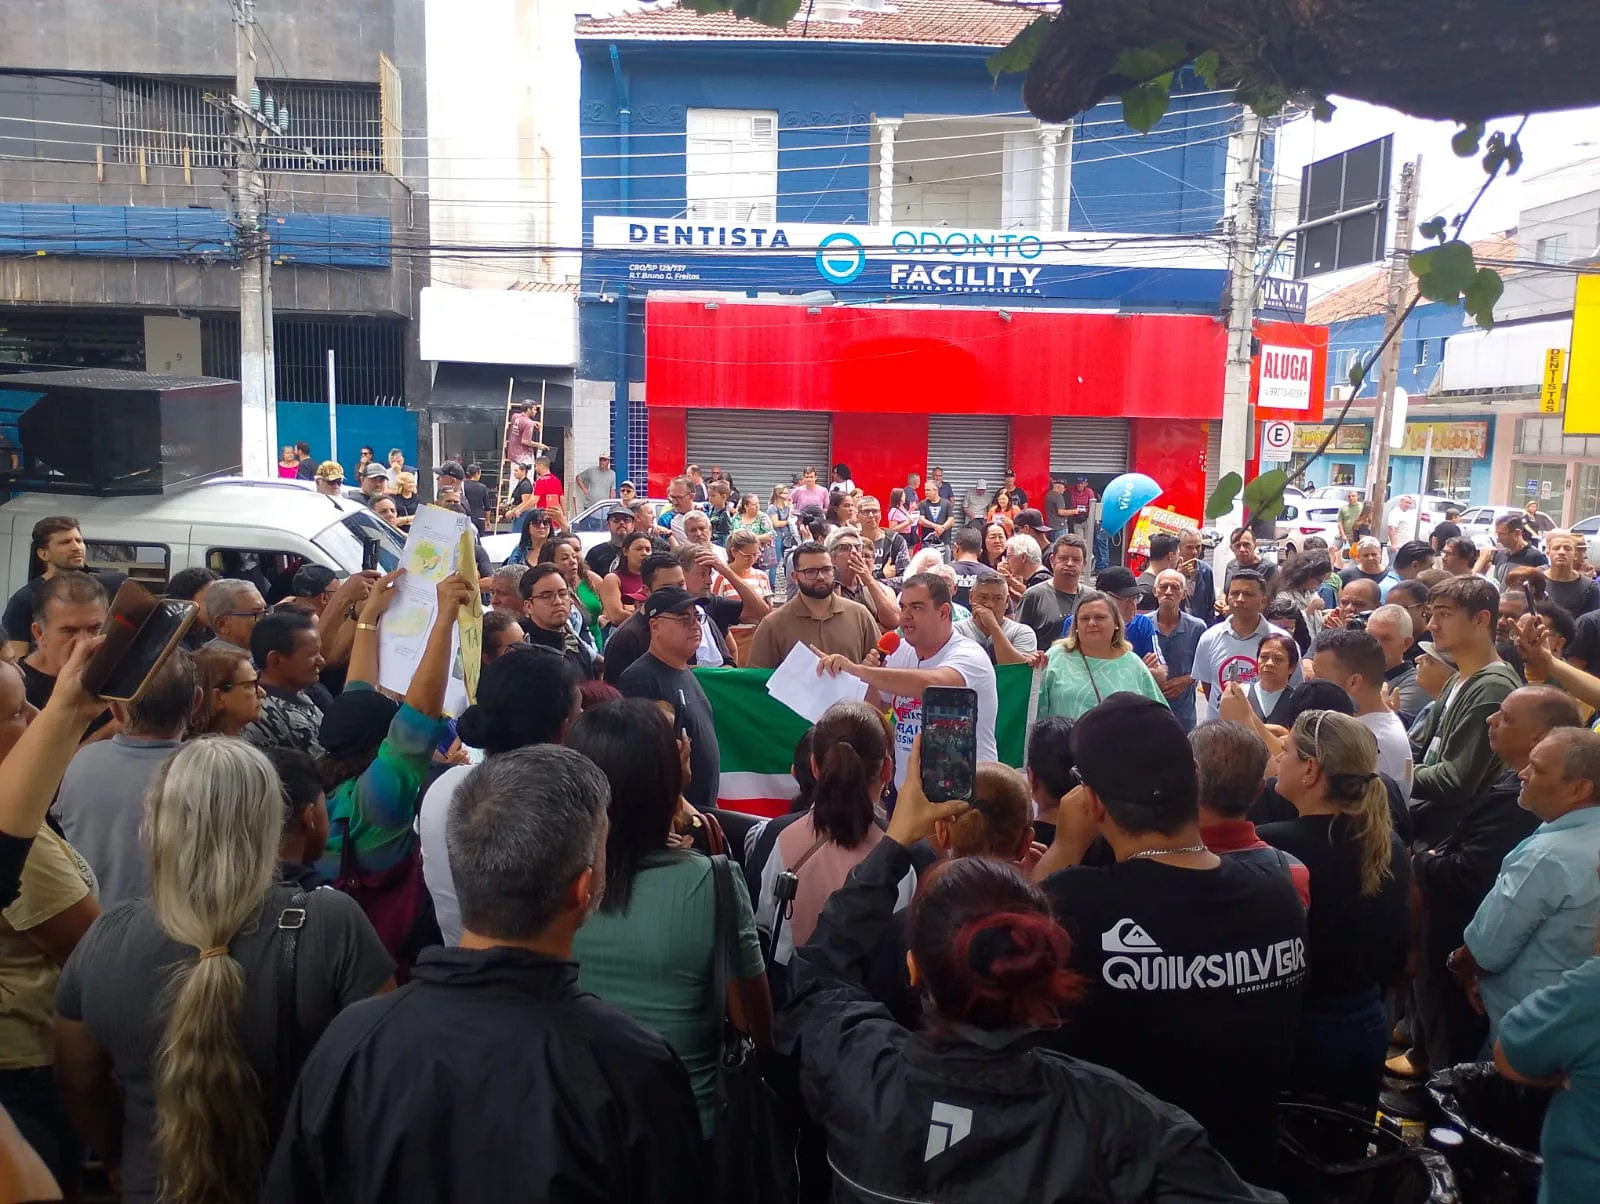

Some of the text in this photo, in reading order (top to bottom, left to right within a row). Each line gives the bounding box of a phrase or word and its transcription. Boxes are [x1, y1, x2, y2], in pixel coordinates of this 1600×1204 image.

[629, 224, 790, 247] DENTISTA
[892, 231, 1043, 259] ODONTO
[890, 264, 1042, 287] FACILITY
[1263, 352, 1308, 382] ALUGA
[1546, 348, 1561, 412] DENTISTAS
[1274, 428, 1284, 442] E
[1236, 980, 1282, 994] BOARDSHORT
